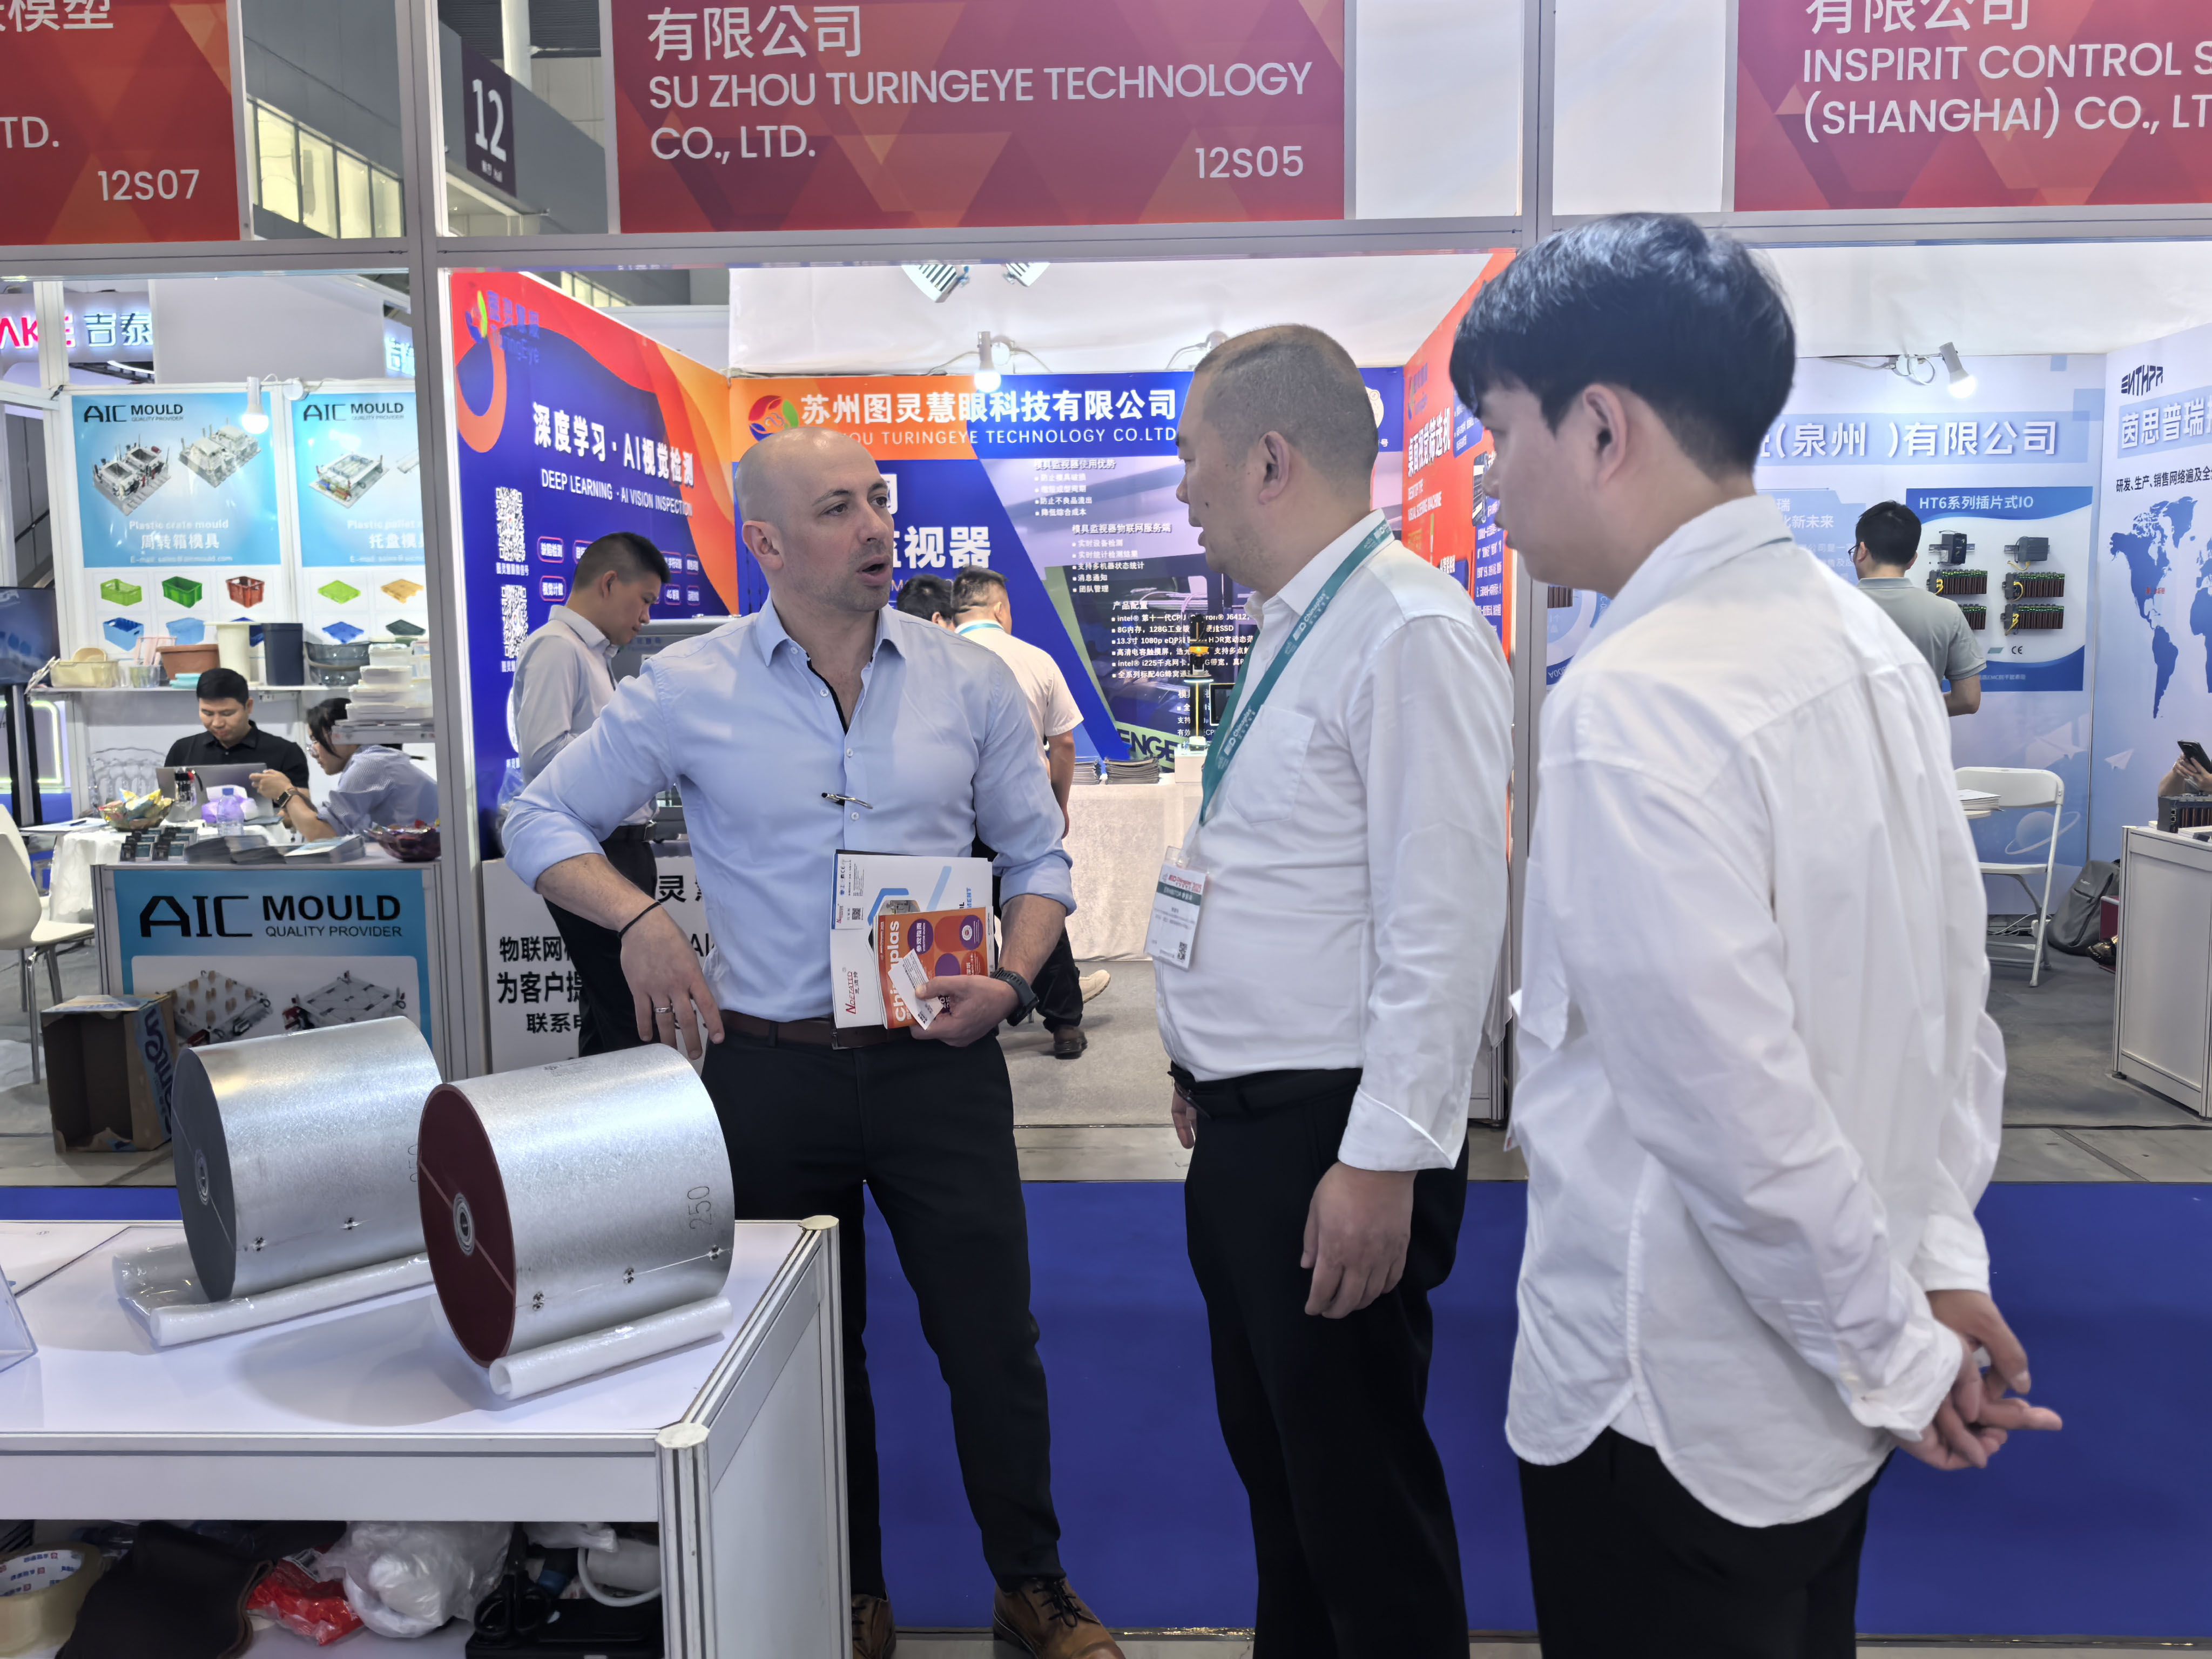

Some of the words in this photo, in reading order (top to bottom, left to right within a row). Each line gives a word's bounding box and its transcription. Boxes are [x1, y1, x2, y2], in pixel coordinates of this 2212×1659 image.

[0, 0, 113, 32] 模塑
[648, 5, 861, 61] 有限公司
[1806, 0, 2028, 34] 有限公司
[1803, 46, 1967, 83] INSPIRIT
[1979, 42, 2181, 80] CONTROL
[650, 76, 697, 109] SU
[709, 73, 815, 107] ZHOU
[826, 69, 1033, 105] TURINGEYE
[1044, 62, 1312, 100] TECHNOLOGY
[473, 79, 507, 163] 12
[1805, 86, 2060, 143] (SHANGHAI)
[2075, 96, 2159, 135] CO.,
[651, 127, 730, 164] CO.,
[741, 125, 816, 158] LTD.
[1195, 145, 1304, 179] 12S05
[98, 169, 200, 201] 12S07
[84, 406, 127, 422] AIC
[131, 404, 184, 415] MOULD
[303, 404, 346, 421] AIC
[350, 402, 404, 414] MOULD
[801, 389, 1176, 425] 苏州图灵慧眼科技有限公司
[883, 430, 978, 445] TURINGEYE
[986, 429, 1106, 444] TECHNOLOGY
[541, 468, 568, 490] DEEP
[570, 475, 613, 500] LEARNING
[630, 489, 653, 509] VISION
[655, 495, 693, 517] INSPECTION
[1919, 495, 2034, 510] HT6系列插片式IO
[130, 521, 163, 530] Plastic
[195, 518, 229, 529] mould
[1112, 601, 1149, 610] 产品配置
[1141, 637, 1163, 645] 1080p
[139, 896, 253, 938] AIC
[264, 895, 401, 921] MOULD
[266, 926, 325, 939] QUALITY
[329, 925, 402, 938] PROVIDER
[500, 935, 572, 963] 物联网
[687, 1185, 711, 1231] 250
